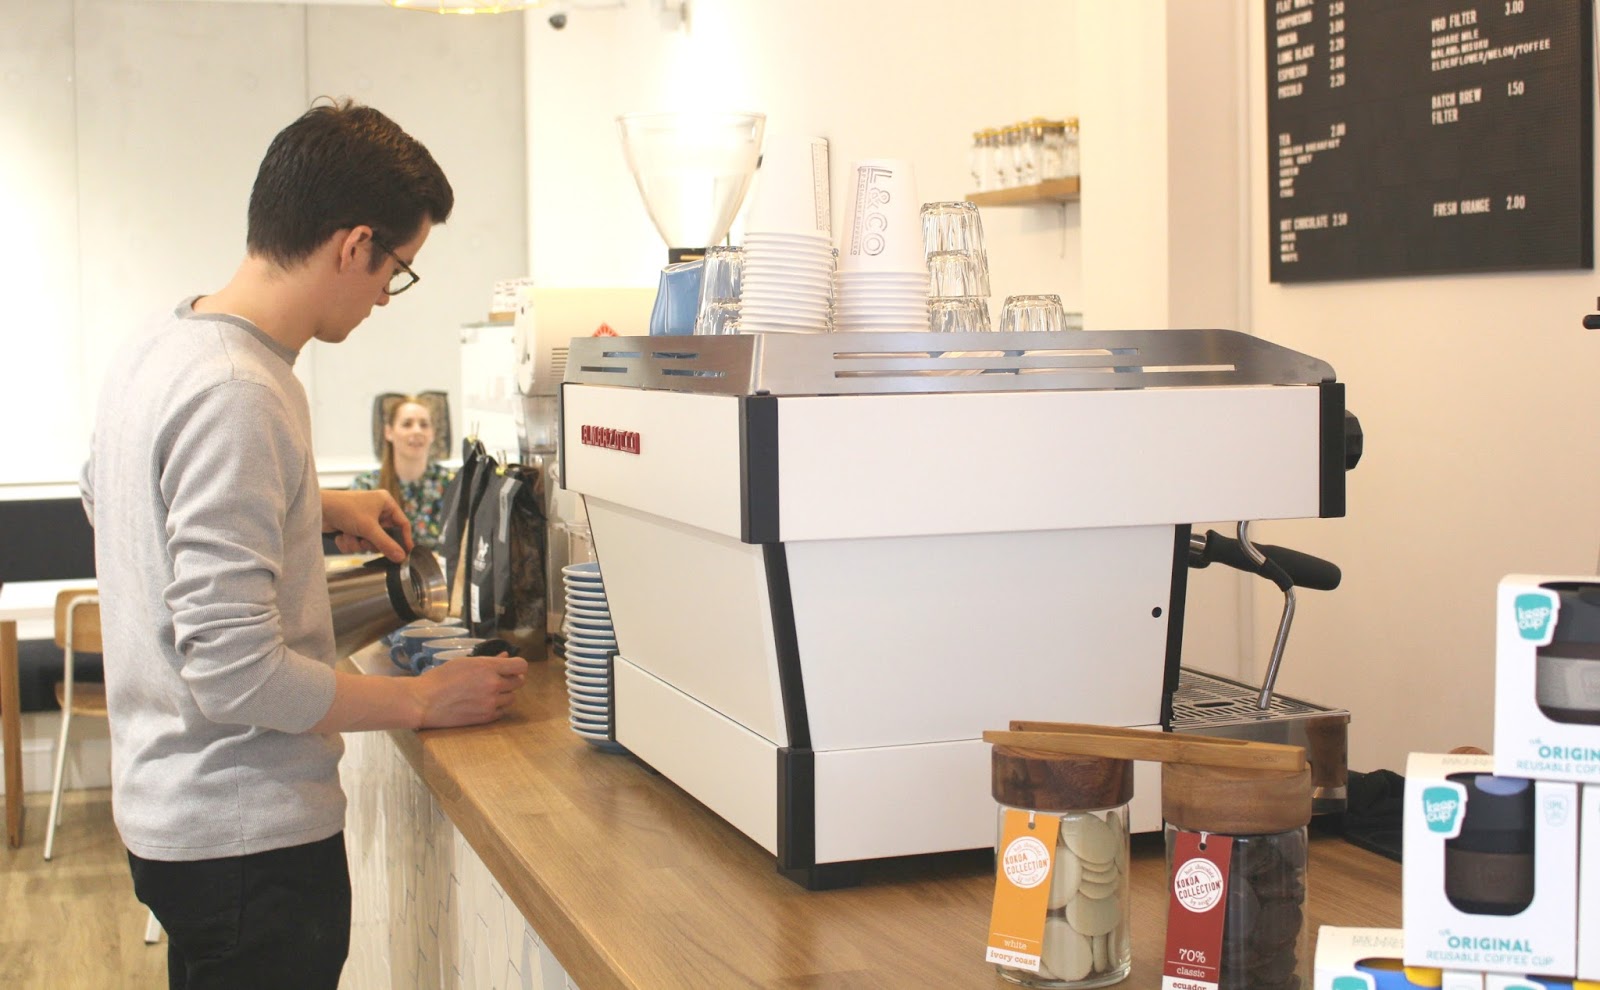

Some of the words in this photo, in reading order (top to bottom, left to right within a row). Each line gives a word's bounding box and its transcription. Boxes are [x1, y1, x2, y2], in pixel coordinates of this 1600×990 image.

[1449, 9, 1477, 29] FILTER
[1505, 0, 1524, 16] 3.00
[1432, 33, 1459, 48] SQUARE
[1461, 28, 1479, 42] MILE
[1294, 44, 1315, 61] BLACK
[1432, 38, 1551, 71] ELDERFLOWER/MELON/TOFFEE
[1432, 92, 1456, 110] BATCH
[1459, 87, 1482, 106] BREW
[1432, 108, 1458, 125] FILTER
[862, 167, 892, 256] L&CO
[1433, 200, 1458, 217] FRESH
[1460, 197, 1491, 214] ORANGE
[1506, 194, 1526, 210] 2.00
[1294, 215, 1328, 230] CHOCOLATE
[1518, 606, 1551, 623] keep
[1519, 615, 1545, 630] cup
[1517, 759, 1571, 771] REUSABLE
[1426, 799, 1459, 814] keep
[1427, 808, 1453, 823] cup
[1005, 852, 1028, 865] KOKOA
[1006, 858, 1048, 875] COLLECTION
[1176, 875, 1200, 889] KOKOA
[1178, 880, 1221, 899] COLLECTION
[1004, 939, 1027, 950] white
[1448, 936, 1532, 953] ORIGINAL
[990, 950, 1013, 963] ivory
[1014, 955, 1037, 966] coast
[1179, 948, 1206, 963] 70%
[1426, 950, 1480, 963] REUSABLE
[1484, 953, 1530, 965] COFFEE
[1532, 956, 1555, 967] CUP
[1176, 966, 1205, 978] classic
[1172, 980, 1207, 990] ecuador
